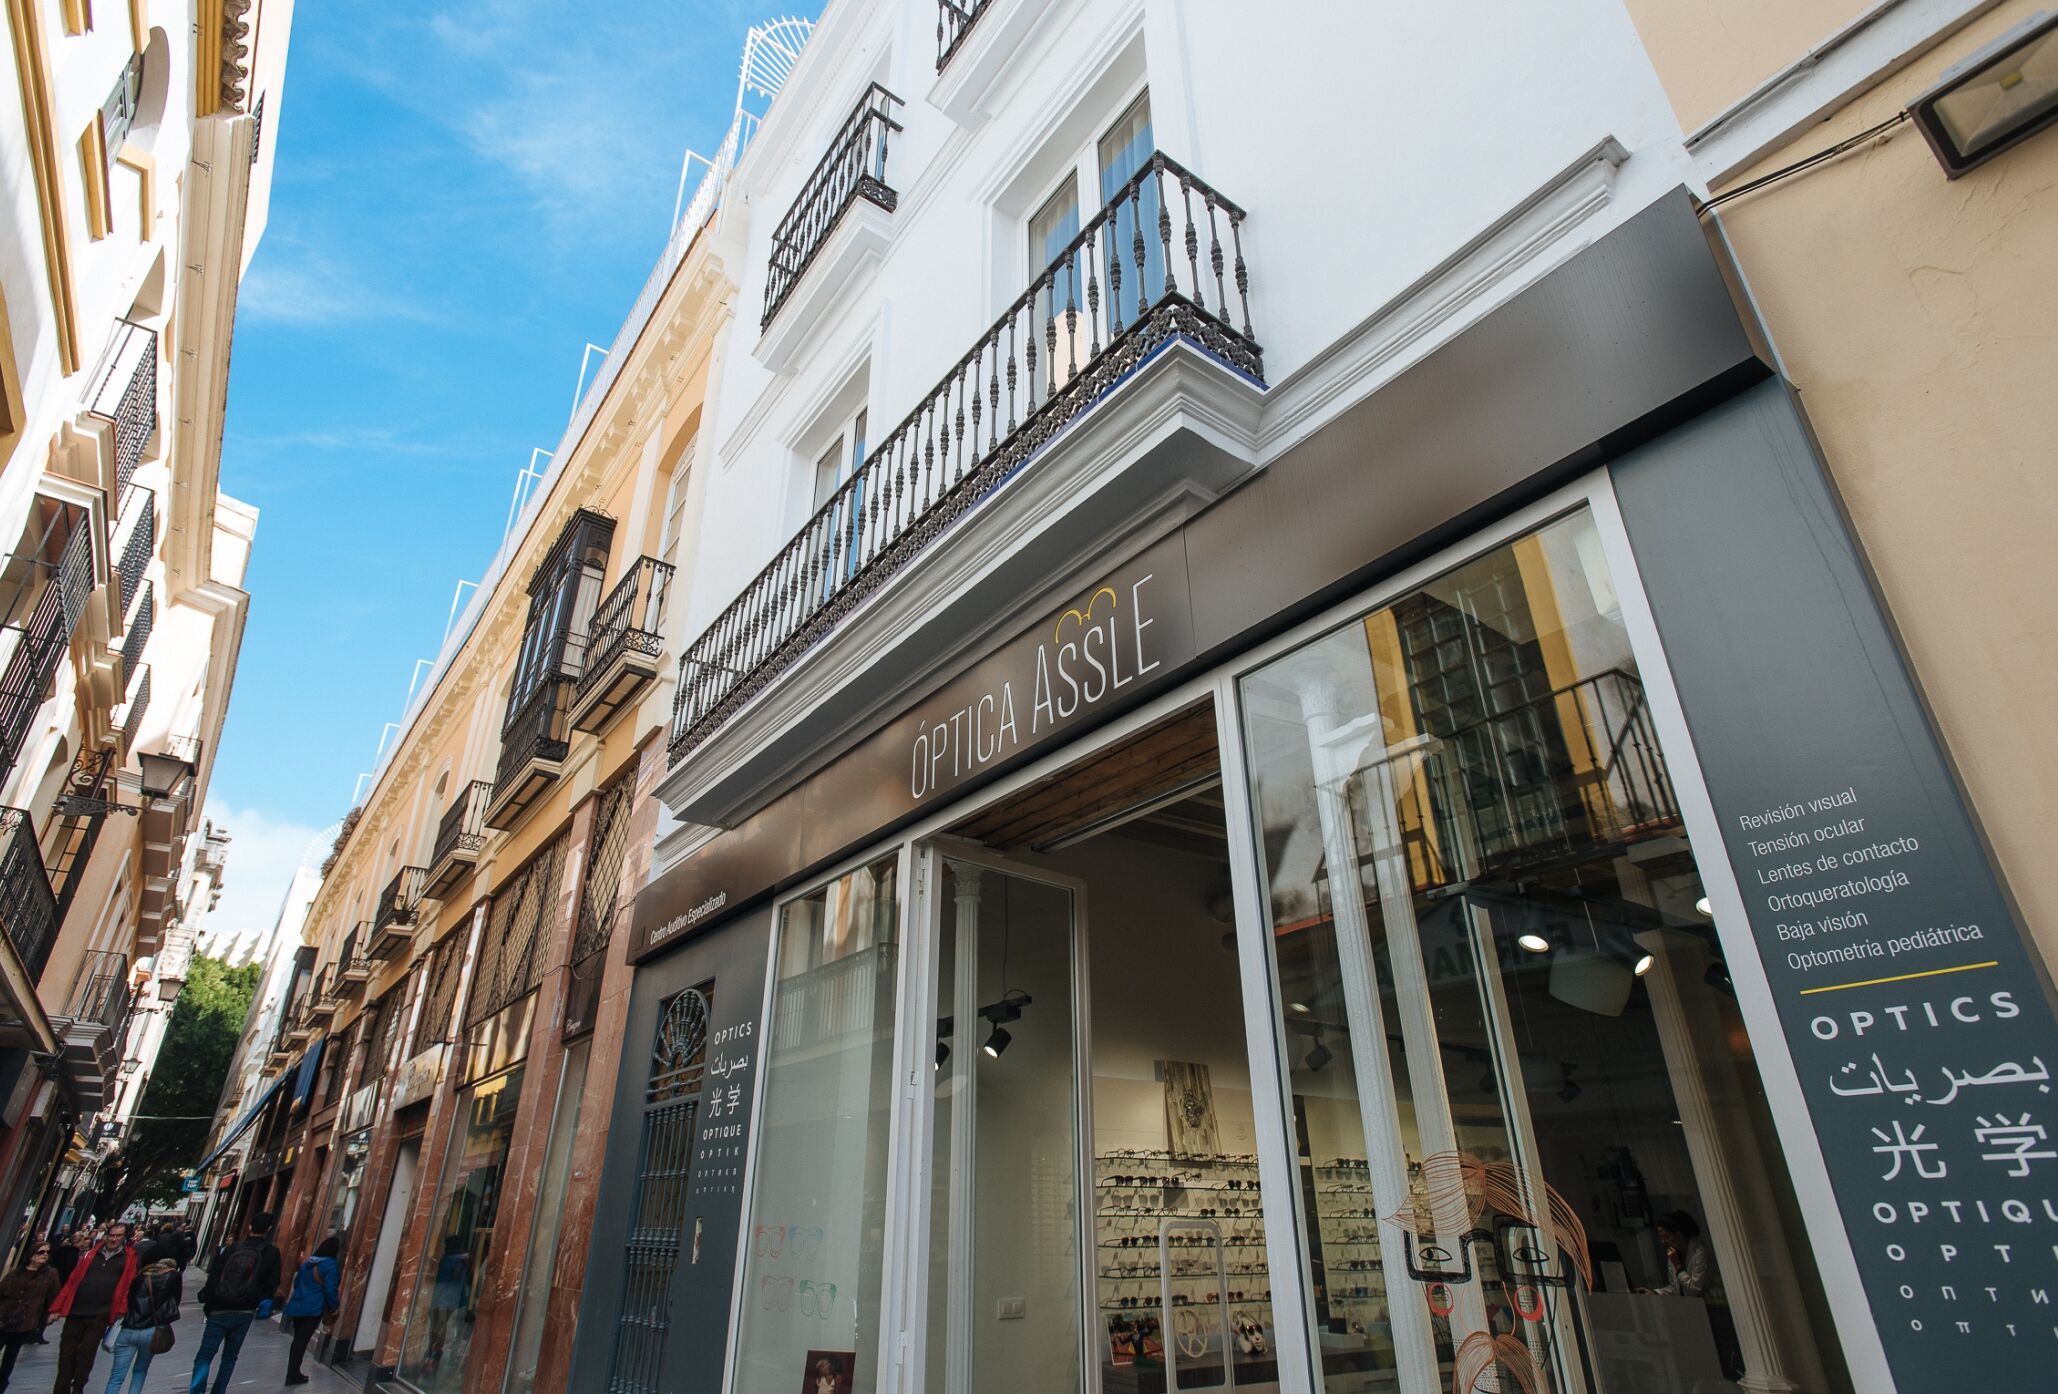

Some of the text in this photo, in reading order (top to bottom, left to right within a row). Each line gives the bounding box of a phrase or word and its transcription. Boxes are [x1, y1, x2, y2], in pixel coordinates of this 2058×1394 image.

[911, 573, 1160, 799] ÓPTICA ASSLE
[1739, 786, 1858, 831] Revisión visual
[1747, 818, 1865, 857] Tensión ocular
[1757, 837, 1919, 885] Lentes de contacto
[1767, 869, 1911, 912] Ortoqueratología
[650, 890, 727, 945] Centro Auditivo Especializado
[1776, 910, 1869, 941] Baja visión
[1886, 923, 1984, 958] pediátrica
[714, 1021, 752, 1045] OPTICS
[1810, 991, 2020, 1041] OPTICS
[708, 1083, 741, 1118] 光学
[1829, 1052, 2050, 1106] بصريات
[700, 1146, 739, 1160] OPTIK
[702, 1124, 741, 1141] OPTIQUE
[1870, 1111, 2058, 1182] 光学
